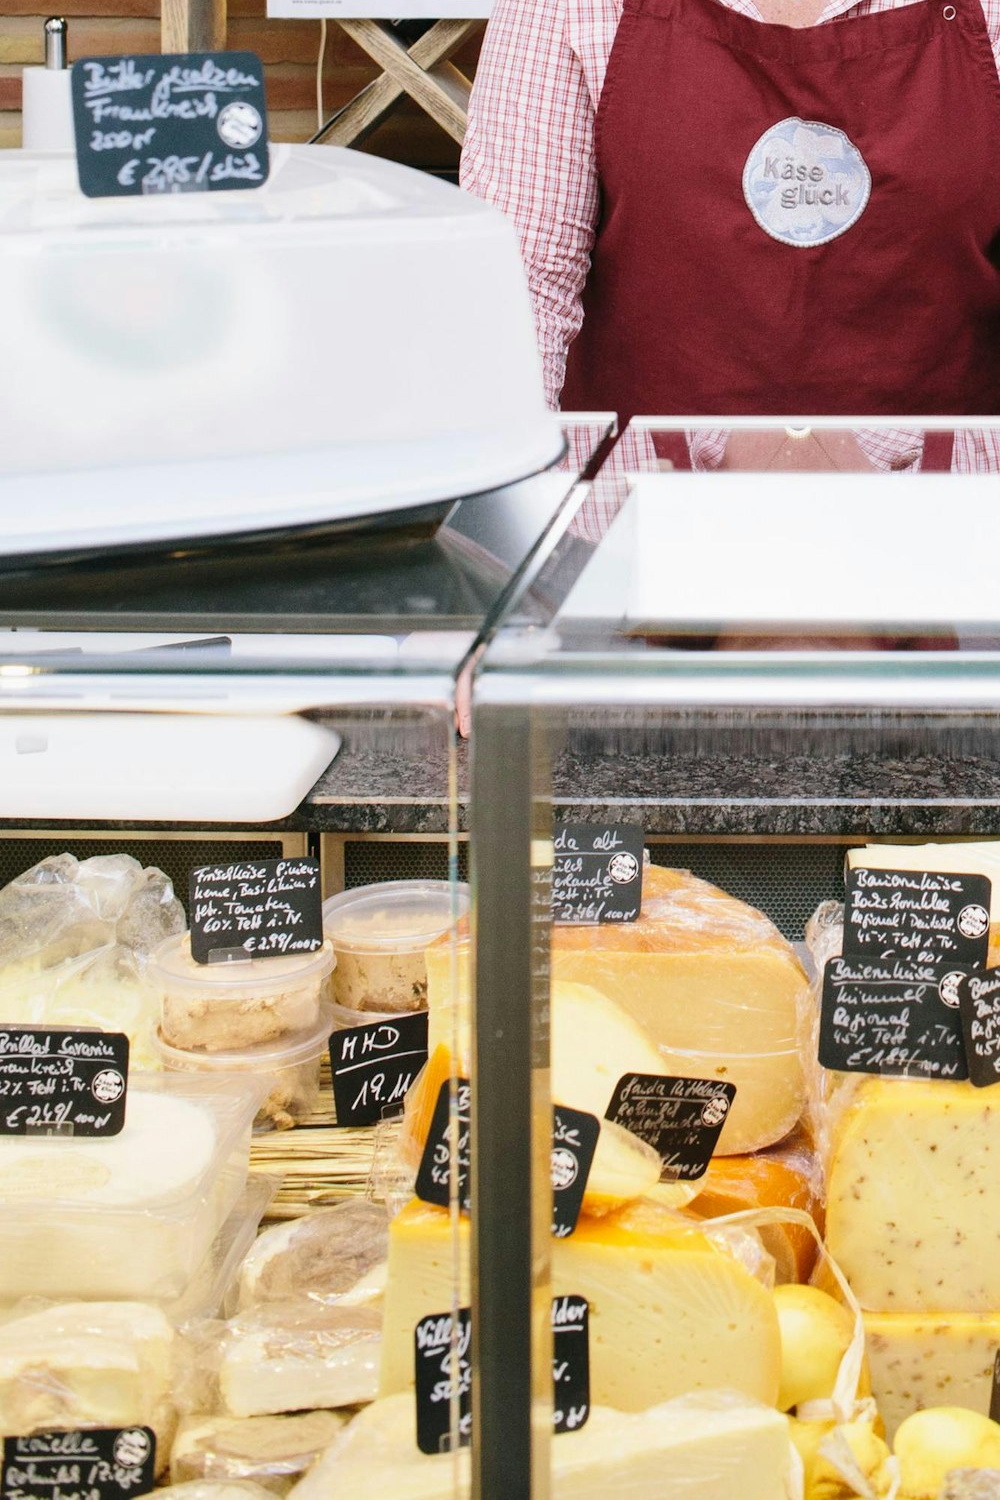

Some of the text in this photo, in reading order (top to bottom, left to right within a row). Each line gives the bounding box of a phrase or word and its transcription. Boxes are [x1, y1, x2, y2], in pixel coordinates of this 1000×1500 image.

[117, 158, 140, 186] €
[763, 156, 824, 182] Käse
[781, 183, 850, 209] glück
[593, 830, 623, 851] alt
[193, 864, 267, 883] Frischkäse
[854, 868, 964, 892] Bauernkäse
[224, 896, 291, 915] Tomaten
[236, 914, 262, 931] Fett
[243, 937, 257, 951] €
[892, 930, 922, 948] Fett
[830, 958, 938, 981] Bauernkäse
[836, 984, 927, 1004] Kümmel
[832, 1006, 910, 1031] Regional
[872, 1026, 907, 1045] Fett
[57, 1036, 115, 1057] Savarin
[0, 1057, 75, 1075] rankreich
[0, 1080, 22, 1095] 2%
[27, 1078, 56, 1095] Fett
[6, 1105, 28, 1128] €
[618, 1099, 681, 1118] Rohmilch
